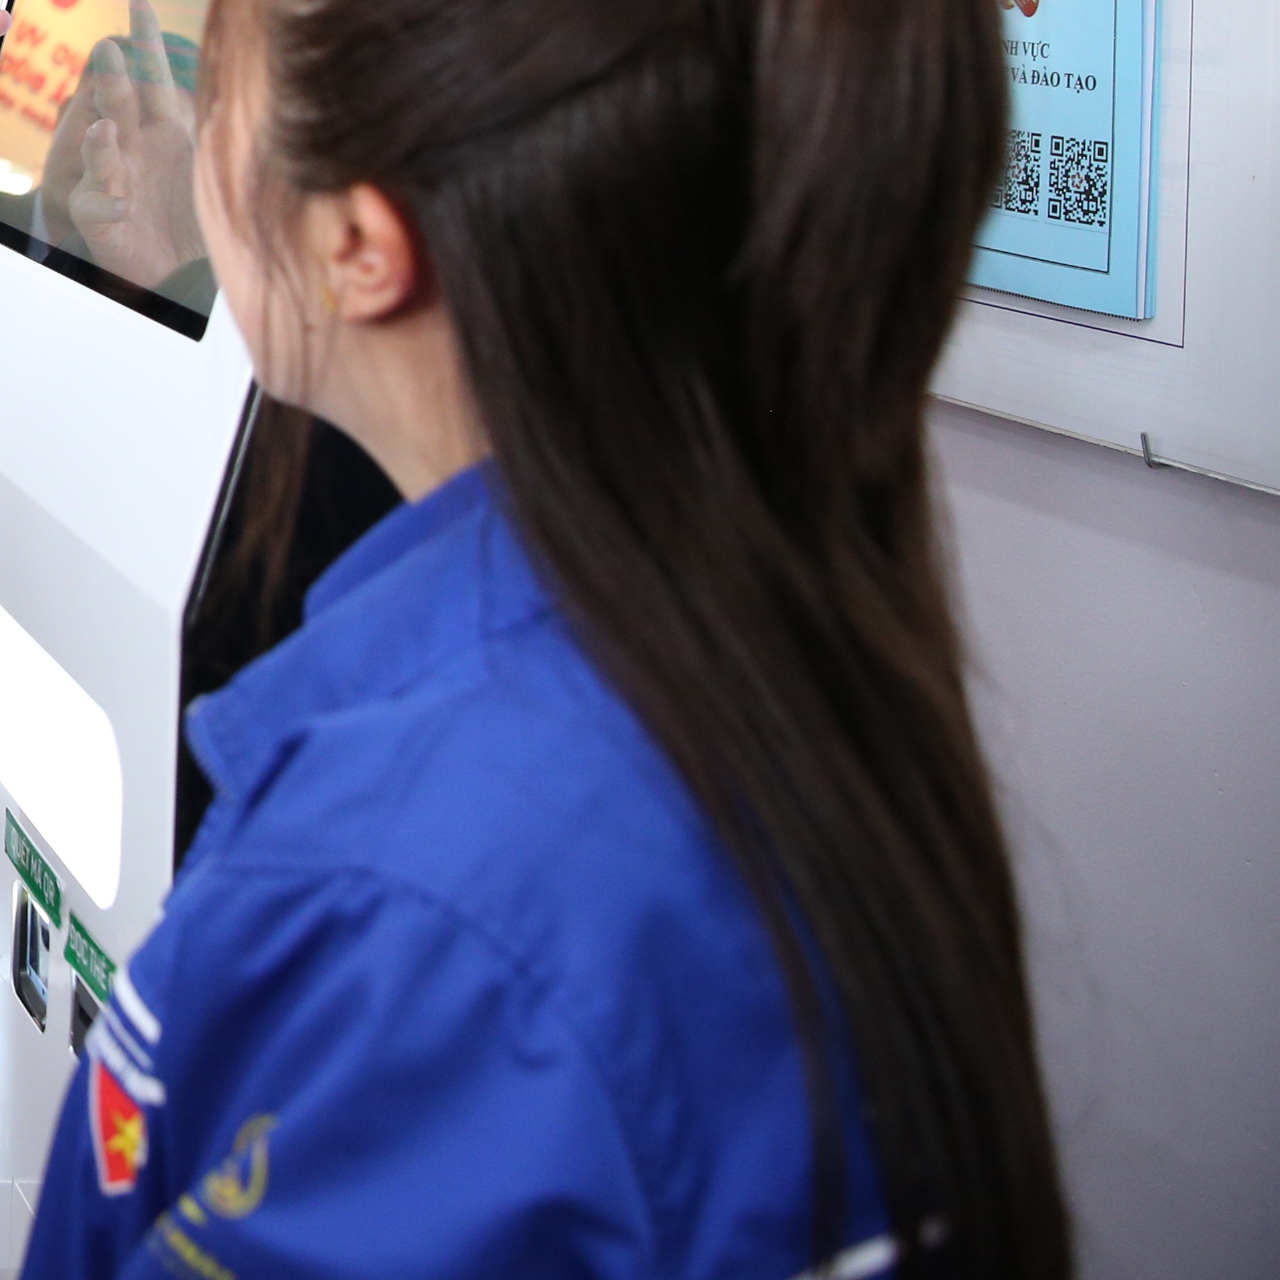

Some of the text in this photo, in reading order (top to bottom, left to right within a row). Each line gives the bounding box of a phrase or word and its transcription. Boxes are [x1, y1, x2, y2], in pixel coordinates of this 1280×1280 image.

[1022, 40, 1050, 61] VỰC
[1011, 63, 1097, 94] VÀ ĐÀO TẠO
